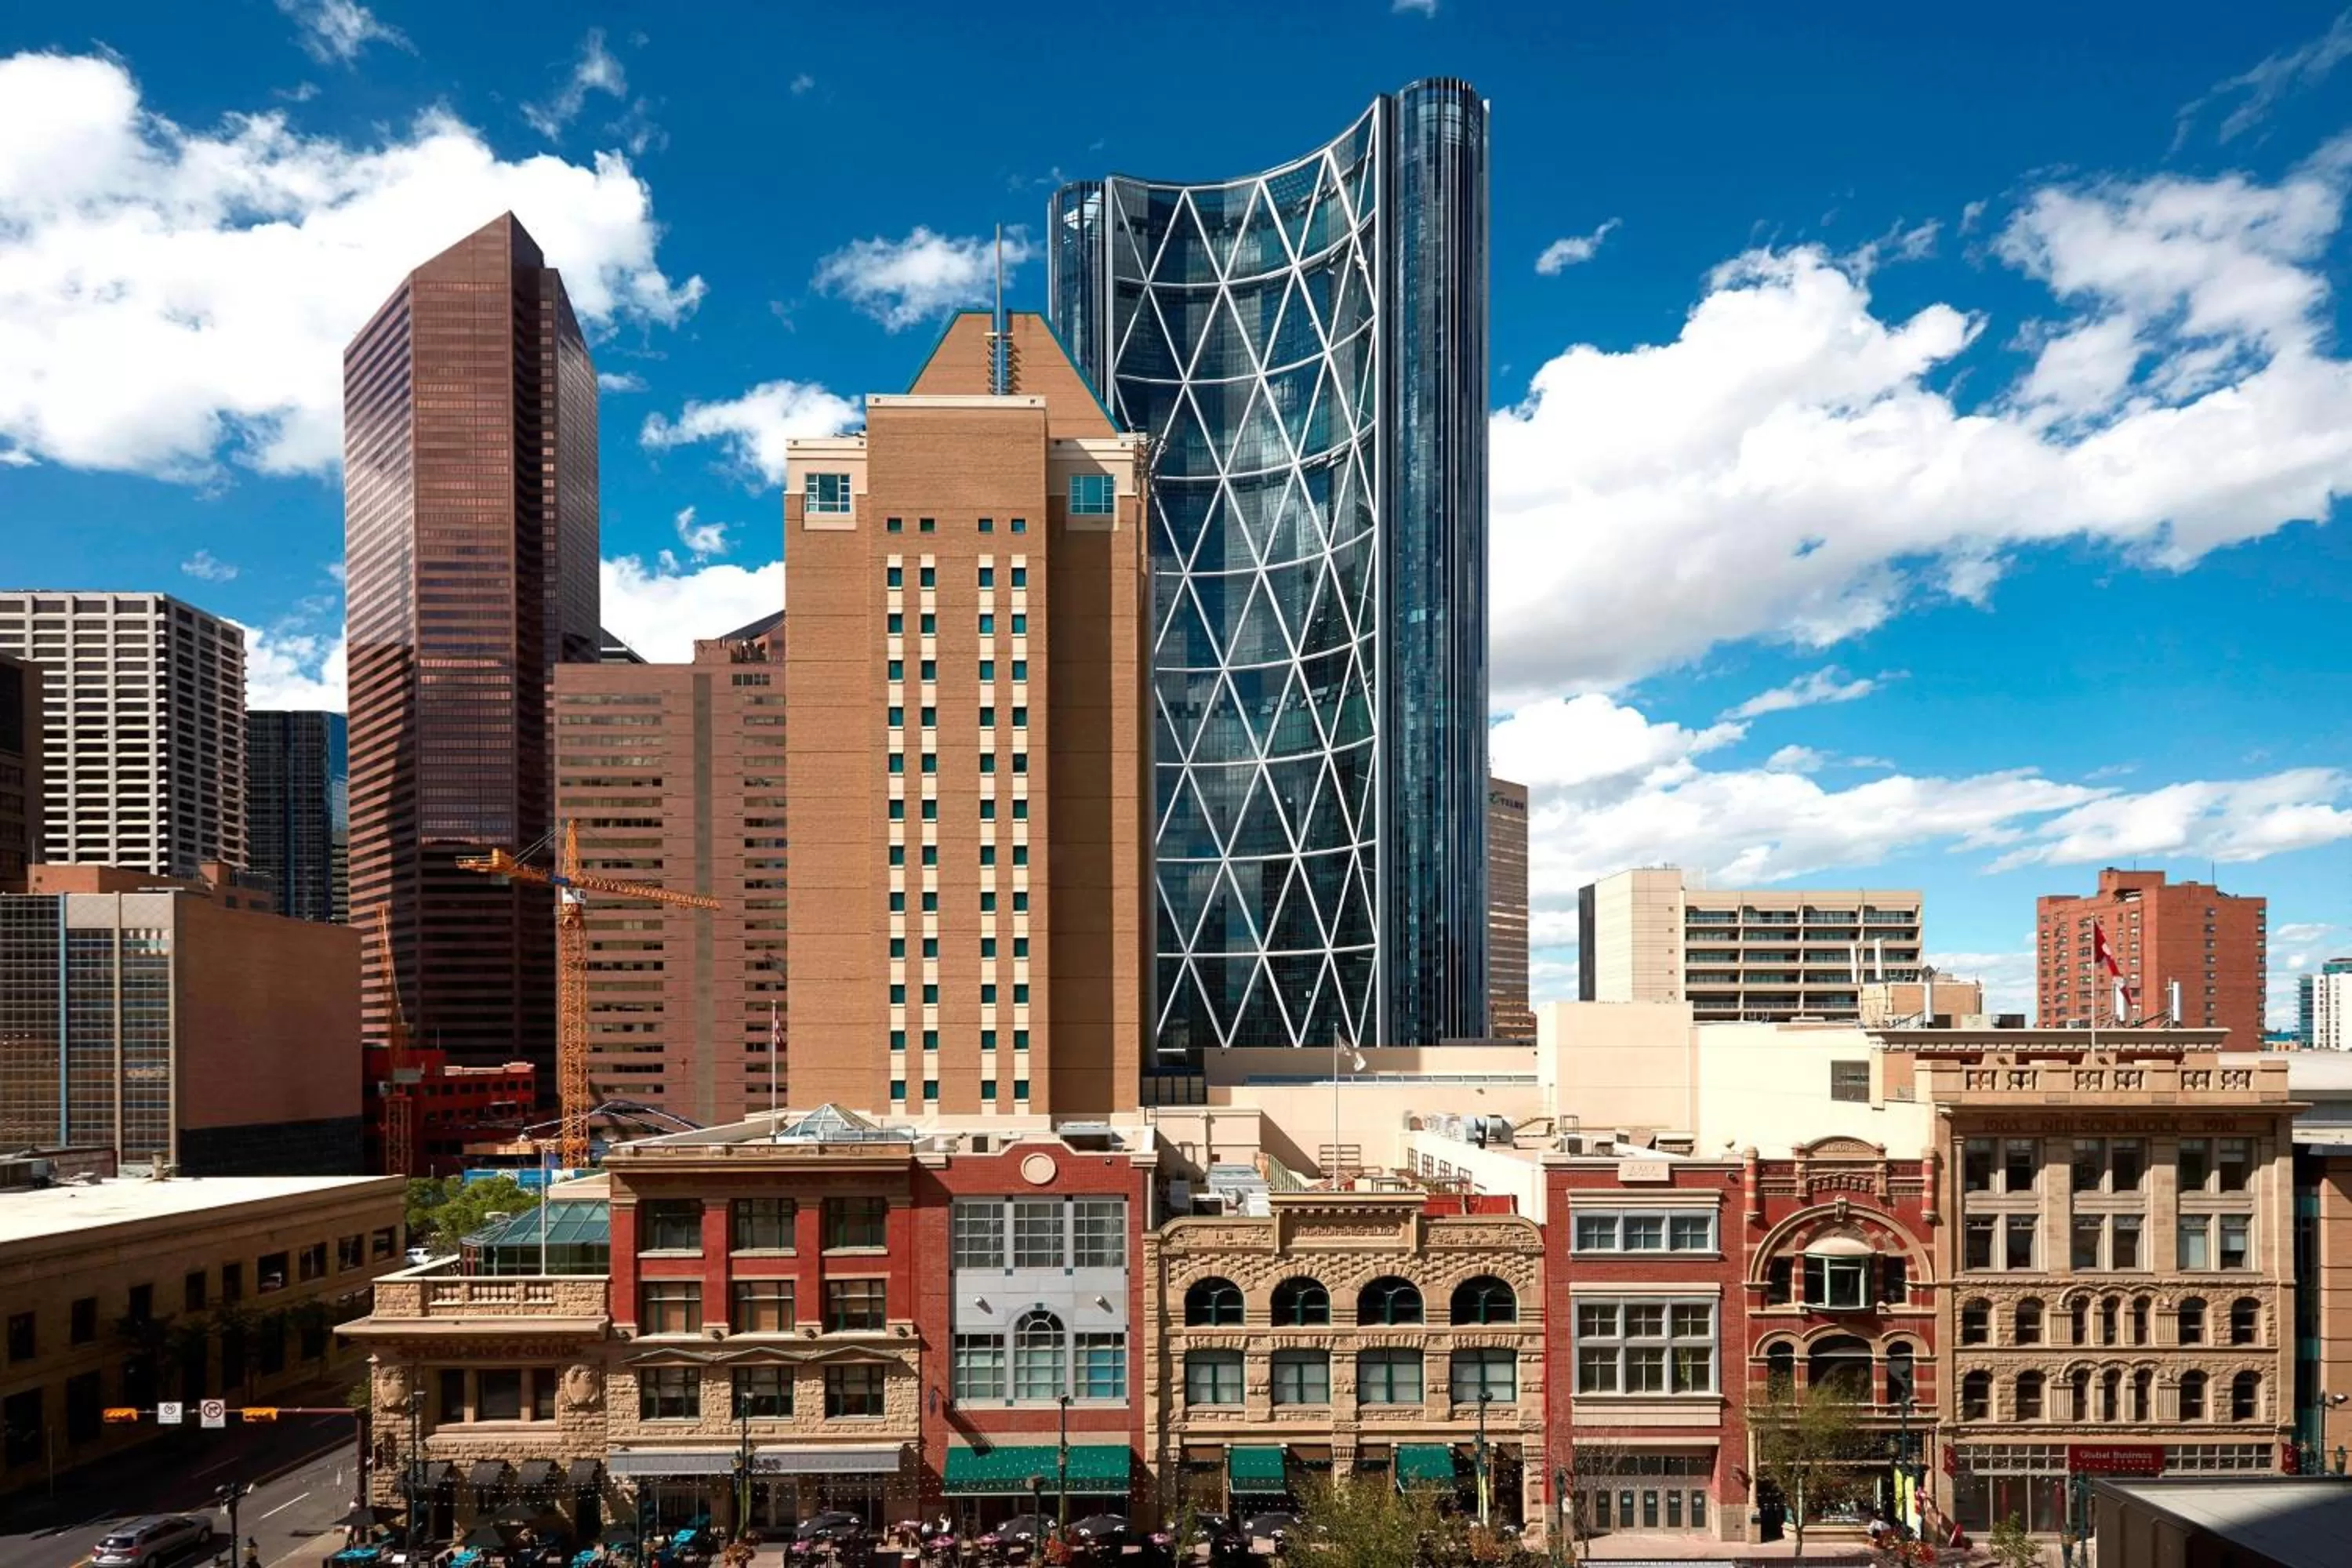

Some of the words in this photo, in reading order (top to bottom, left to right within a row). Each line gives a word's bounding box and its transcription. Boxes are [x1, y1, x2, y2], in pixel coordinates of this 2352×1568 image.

[2040, 1118, 2116, 1132] NEILSON
[2122, 1118, 2181, 1132] BLOCK
[2203, 1118, 2237, 1132] 1910
